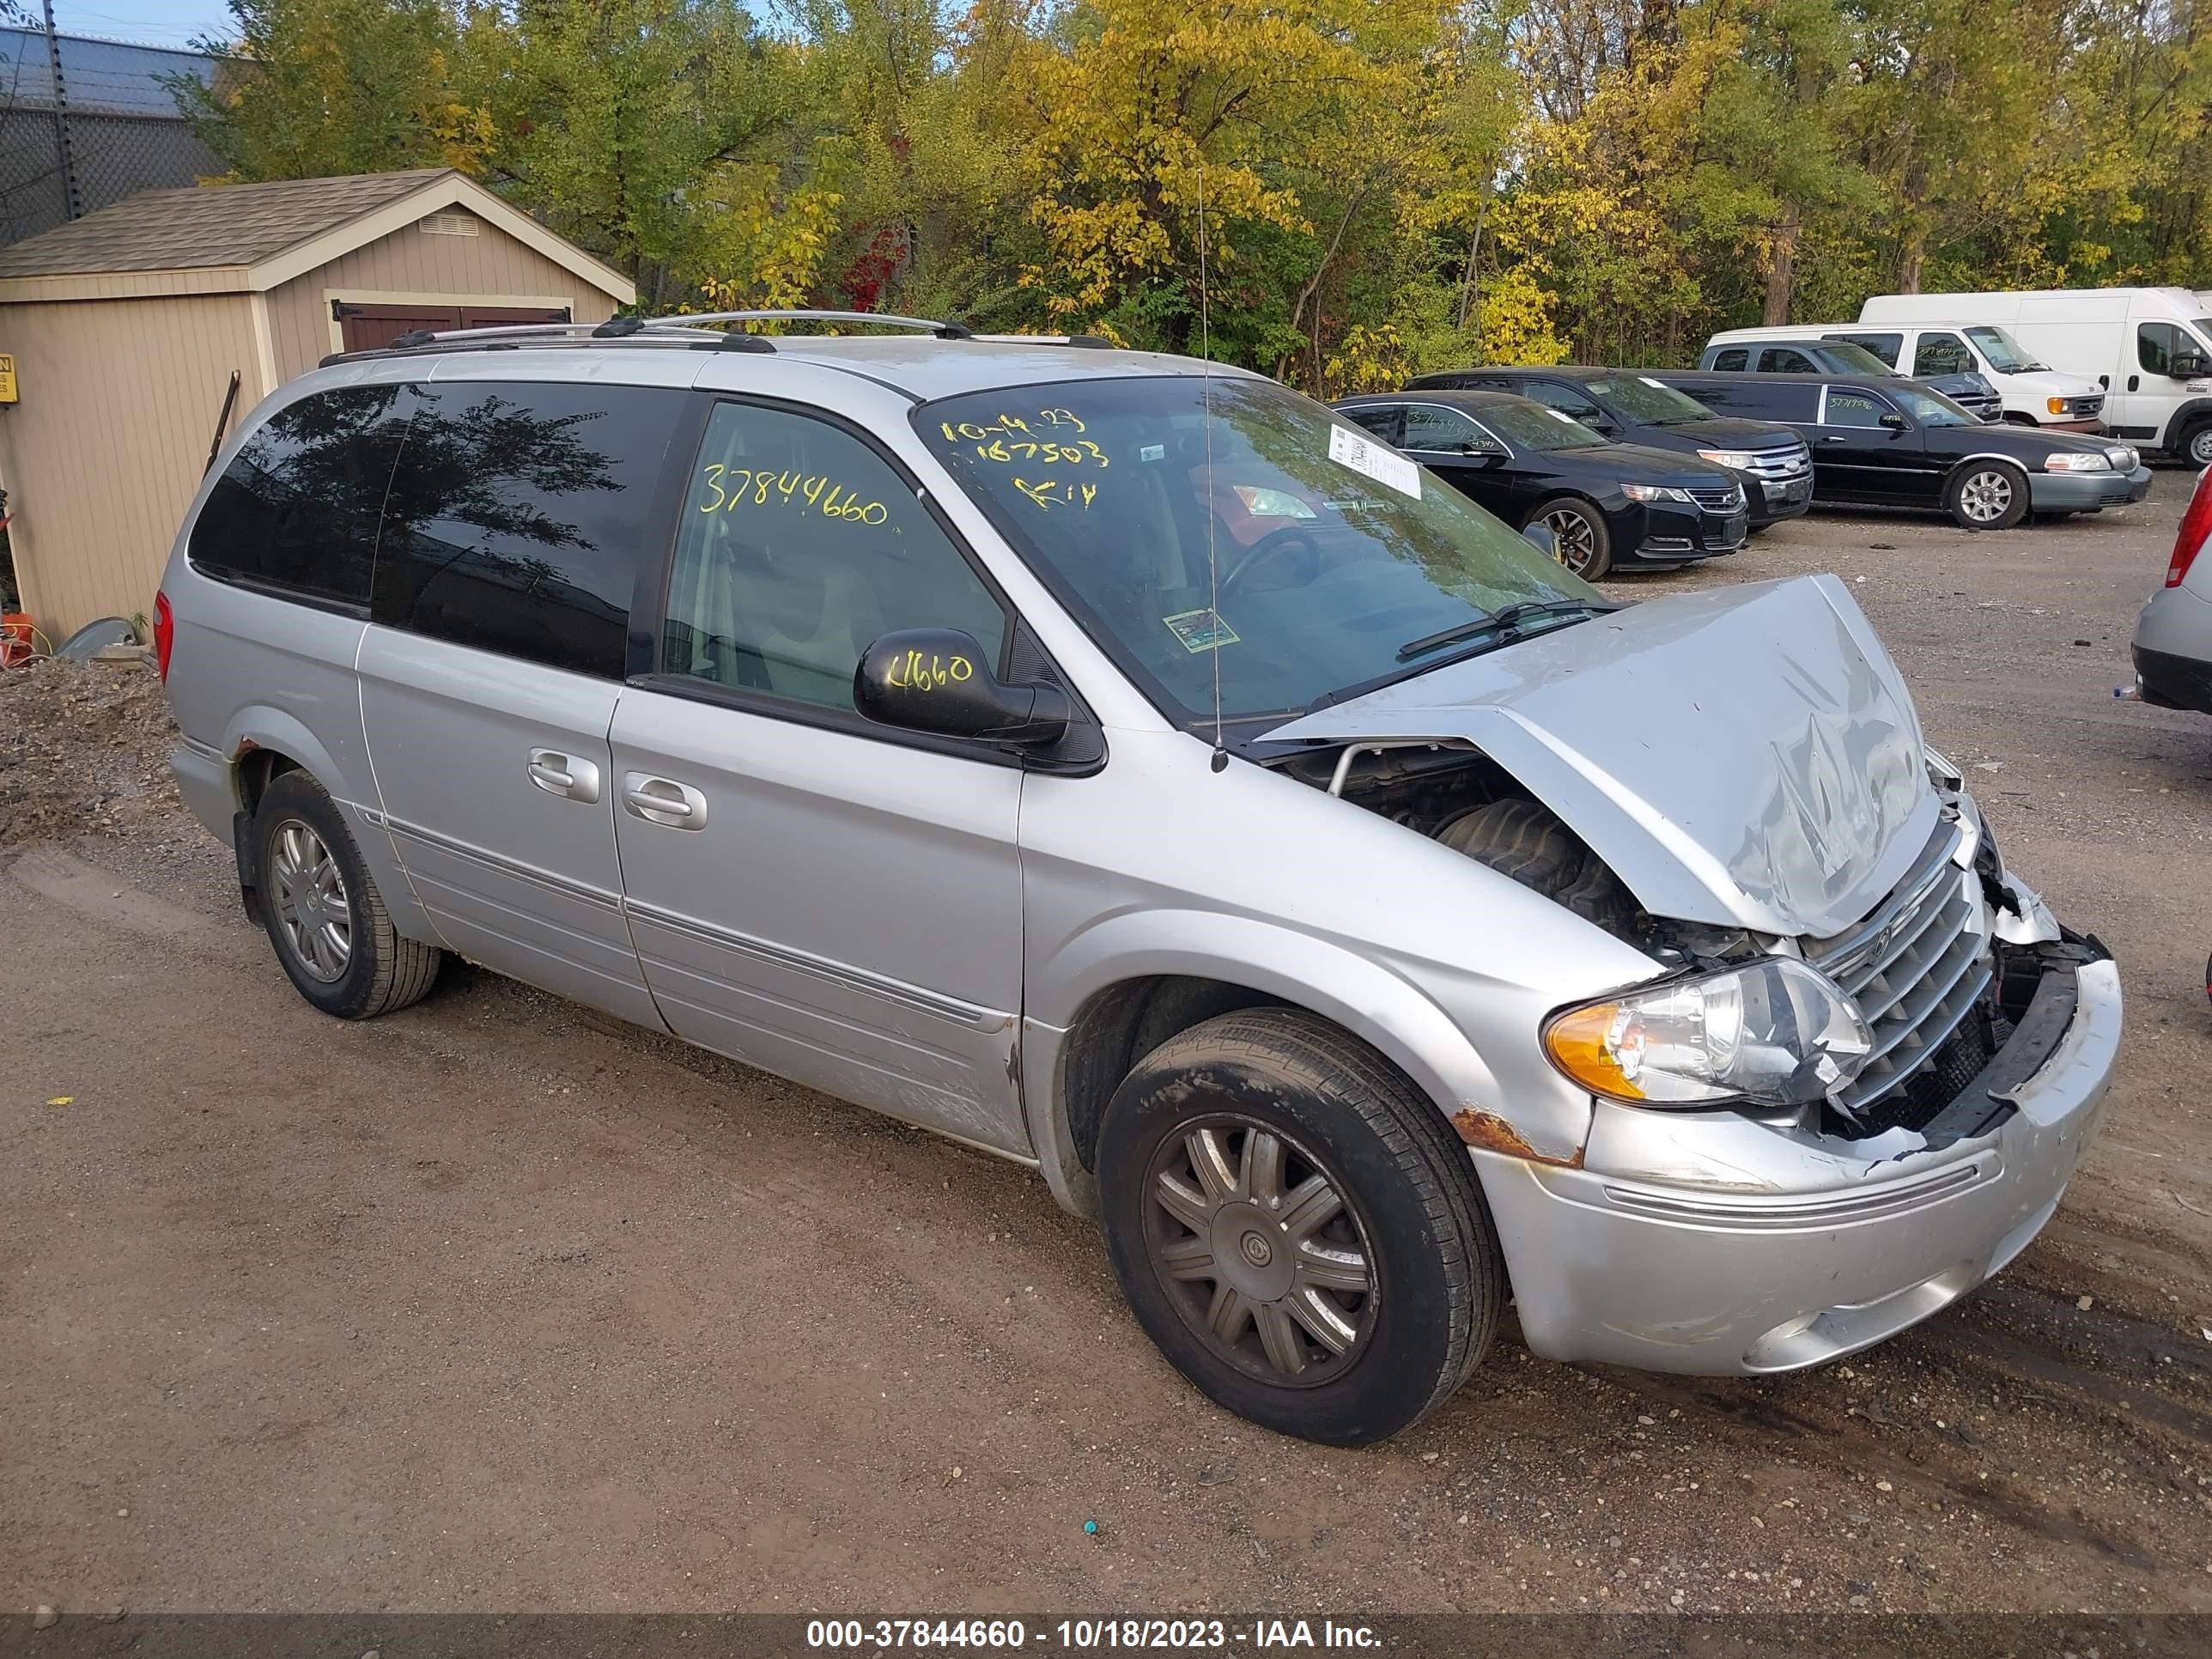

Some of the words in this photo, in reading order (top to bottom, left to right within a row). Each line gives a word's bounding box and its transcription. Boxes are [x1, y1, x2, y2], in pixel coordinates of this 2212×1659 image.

[976, 439, 1110, 468] 167503
[699, 463, 889, 526] 37844660
[887, 649, 974, 693] 4660
